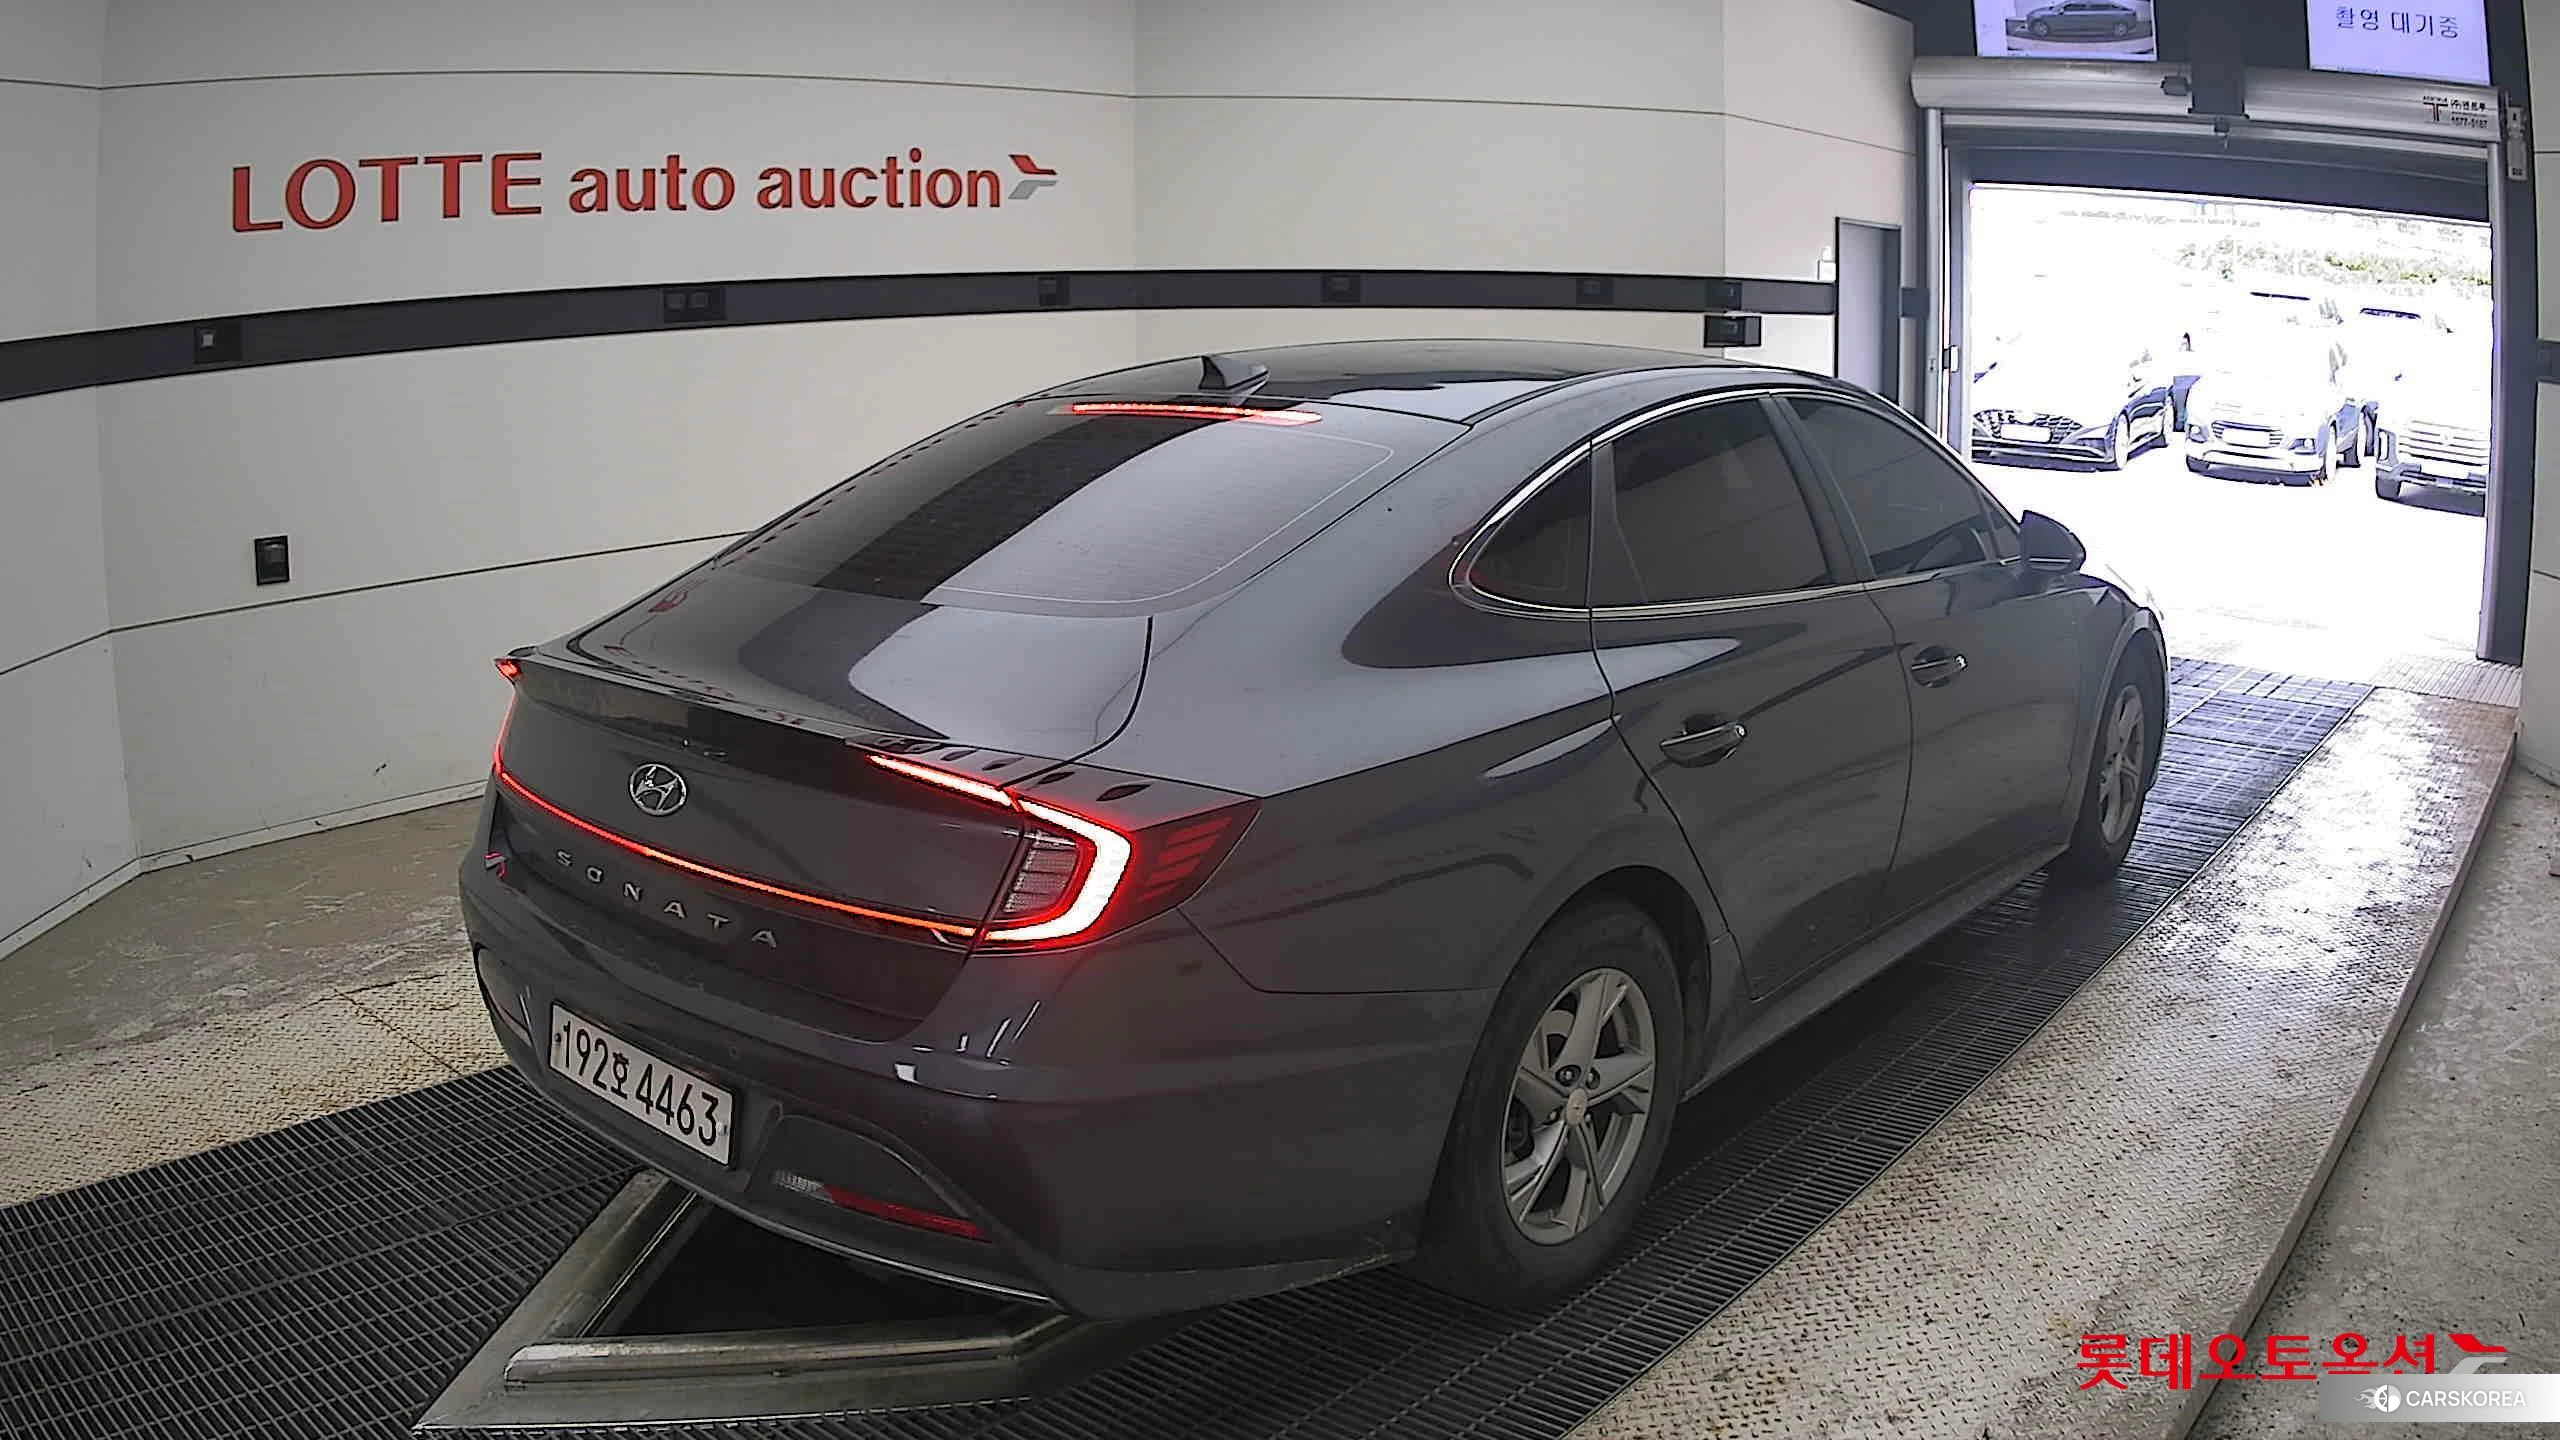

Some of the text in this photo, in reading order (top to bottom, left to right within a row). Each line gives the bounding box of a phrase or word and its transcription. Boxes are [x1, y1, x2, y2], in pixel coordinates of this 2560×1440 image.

[2336, 6, 2459, 39] 촬영 대기중
[231, 147, 1001, 233] LOTTE auto auction
[555, 849, 779, 950] SONATA
